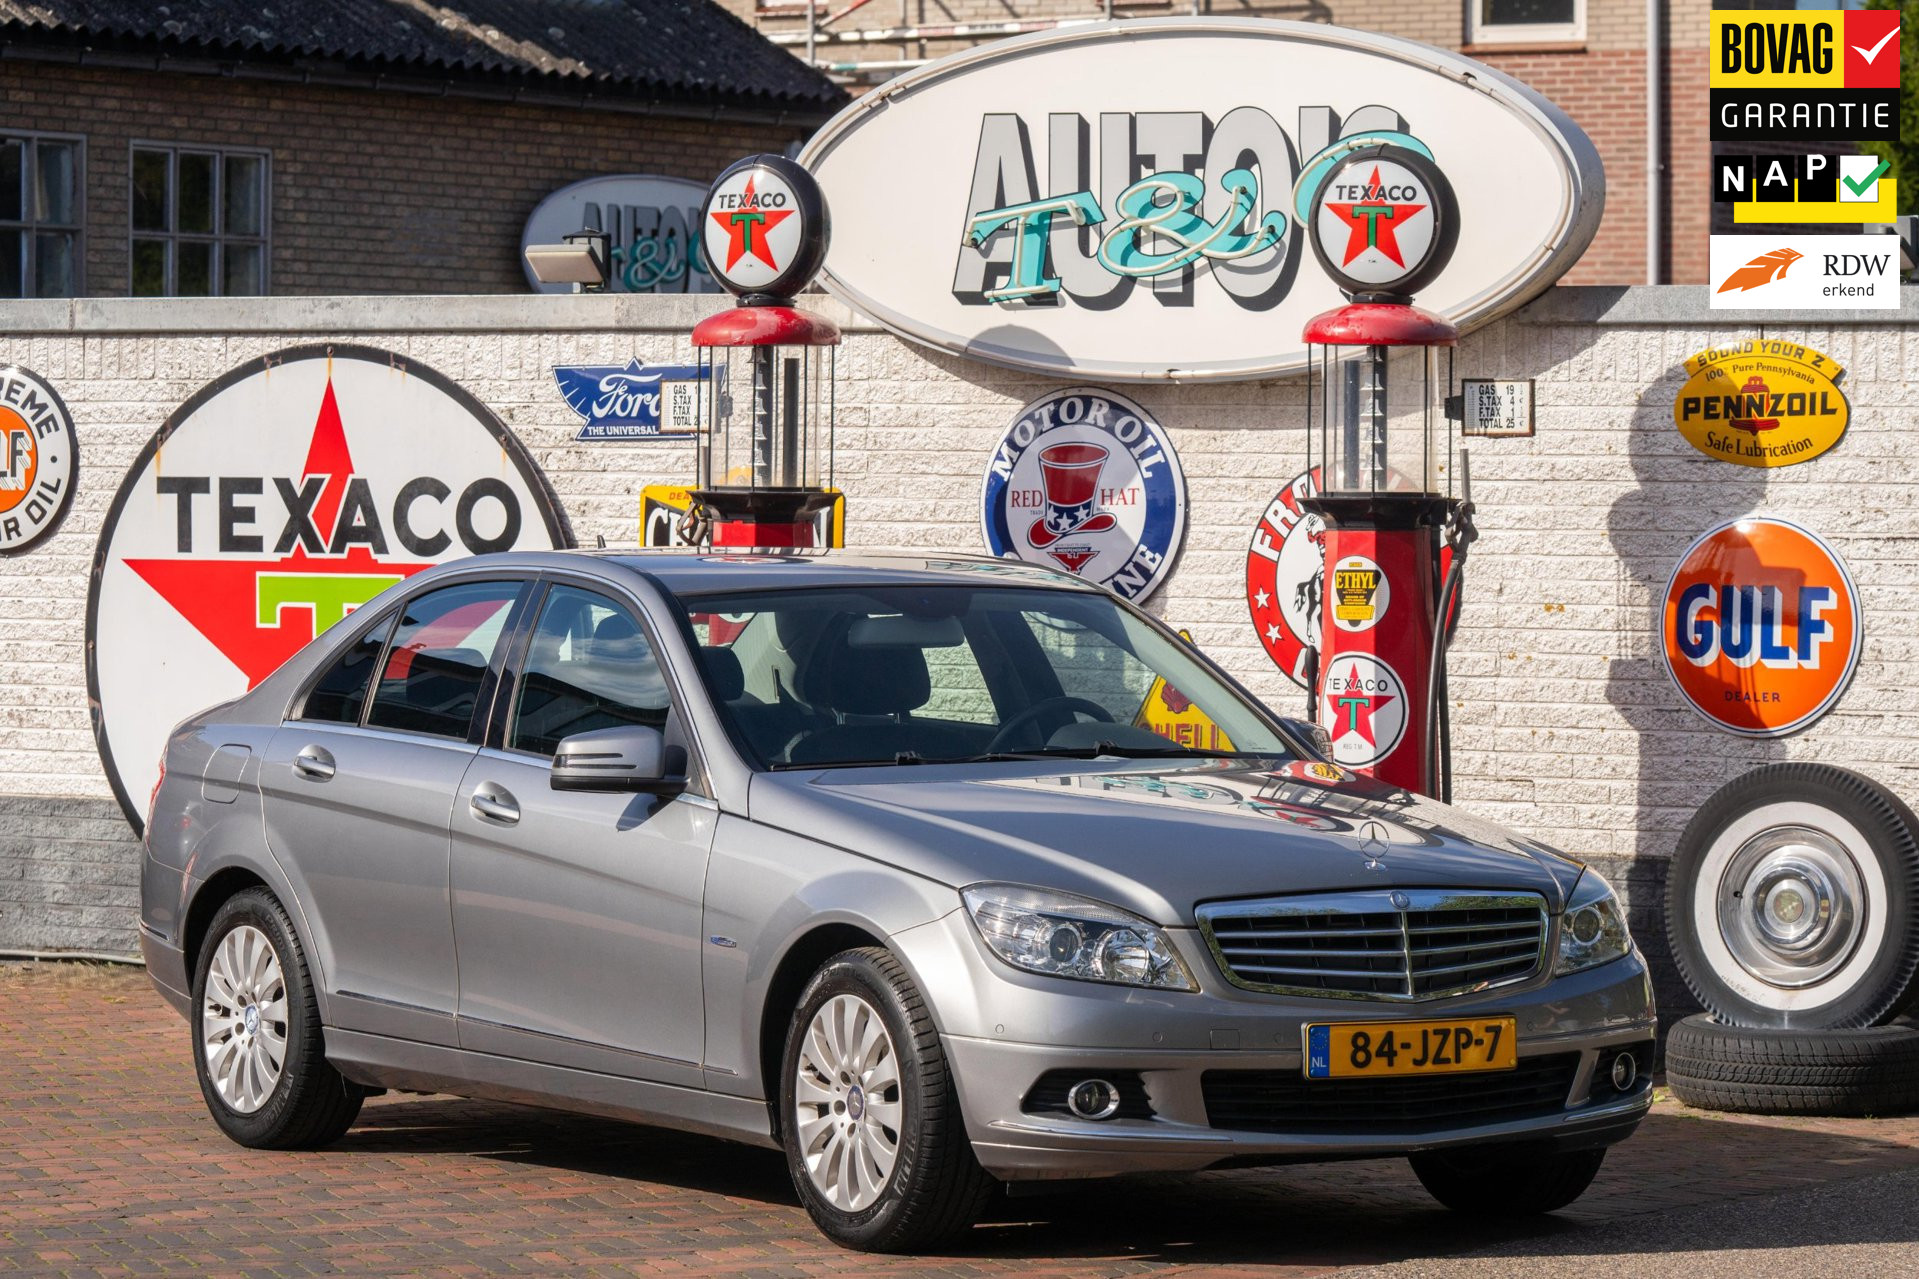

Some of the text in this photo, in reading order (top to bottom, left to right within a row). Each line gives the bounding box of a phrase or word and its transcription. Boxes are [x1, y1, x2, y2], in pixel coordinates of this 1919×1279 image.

[719, 193, 786, 208] TEXACO
[1335, 185, 1417, 202] TEXACO
[730, 213, 766, 253] T
[1352, 205, 1394, 248] T
[1760, 342, 1804, 360] YOUR
[1811, 355, 1826, 368] Z
[1732, 364, 1754, 374] Pure
[1756, 362, 1815, 384] Pennsylvania
[673, 385, 687, 395] GAS
[1479, 385, 1515, 395] GAS 19
[673, 395, 691, 405] S.TAX
[1479, 396, 1515, 406] S.TAX 4
[1683, 391, 1838, 421] PENNZOIL
[673, 405, 691, 415] F.TAX
[1479, 407, 1501, 417] F.TAX
[673, 416, 692, 426] TOTAL
[1479, 418, 1515, 428] TOTAL 25
[587, 426, 659, 435] THE UNIVERSAL
[992, 397, 1165, 482] MOTOR OIL
[1705, 431, 1813, 457] Safe Lubrication
[25, 478, 61, 525] OIL
[1011, 488, 1139, 508] RED HAT
[157, 476, 522, 557] TEXACO
[1336, 572, 1376, 589] ETHYL
[1676, 584, 1837, 669] GULF
[1329, 678, 1388, 692] TEXACO
[1724, 690, 1781, 703] DEALER
[1312, 1025, 1503, 1069] NL 84-JZP-7
